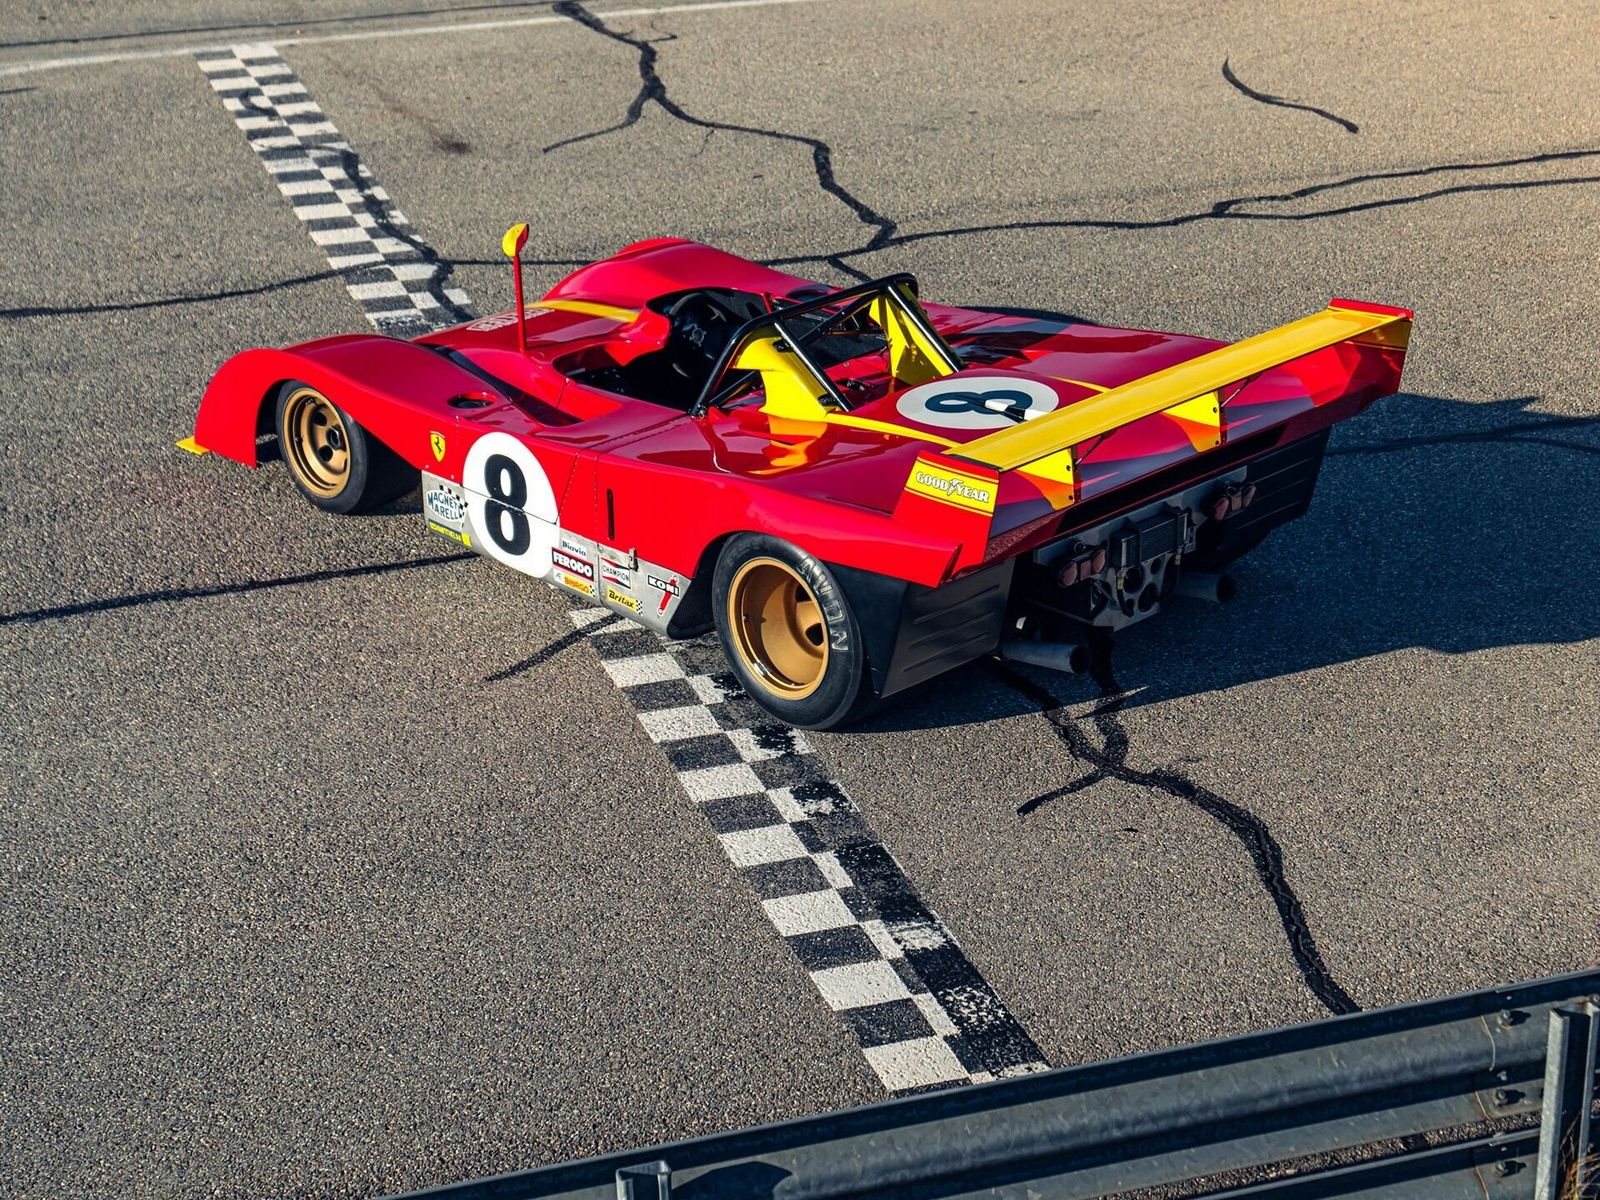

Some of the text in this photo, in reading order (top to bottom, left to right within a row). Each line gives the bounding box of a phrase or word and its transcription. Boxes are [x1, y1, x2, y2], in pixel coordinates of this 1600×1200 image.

[924, 389, 1034, 415] 8
[484, 453, 531, 556] 8
[553, 551, 593, 578] FERODO
[602, 564, 630, 581] CHAMPION
[648, 575, 679, 597] KONI
[608, 589, 634, 609] Britax
